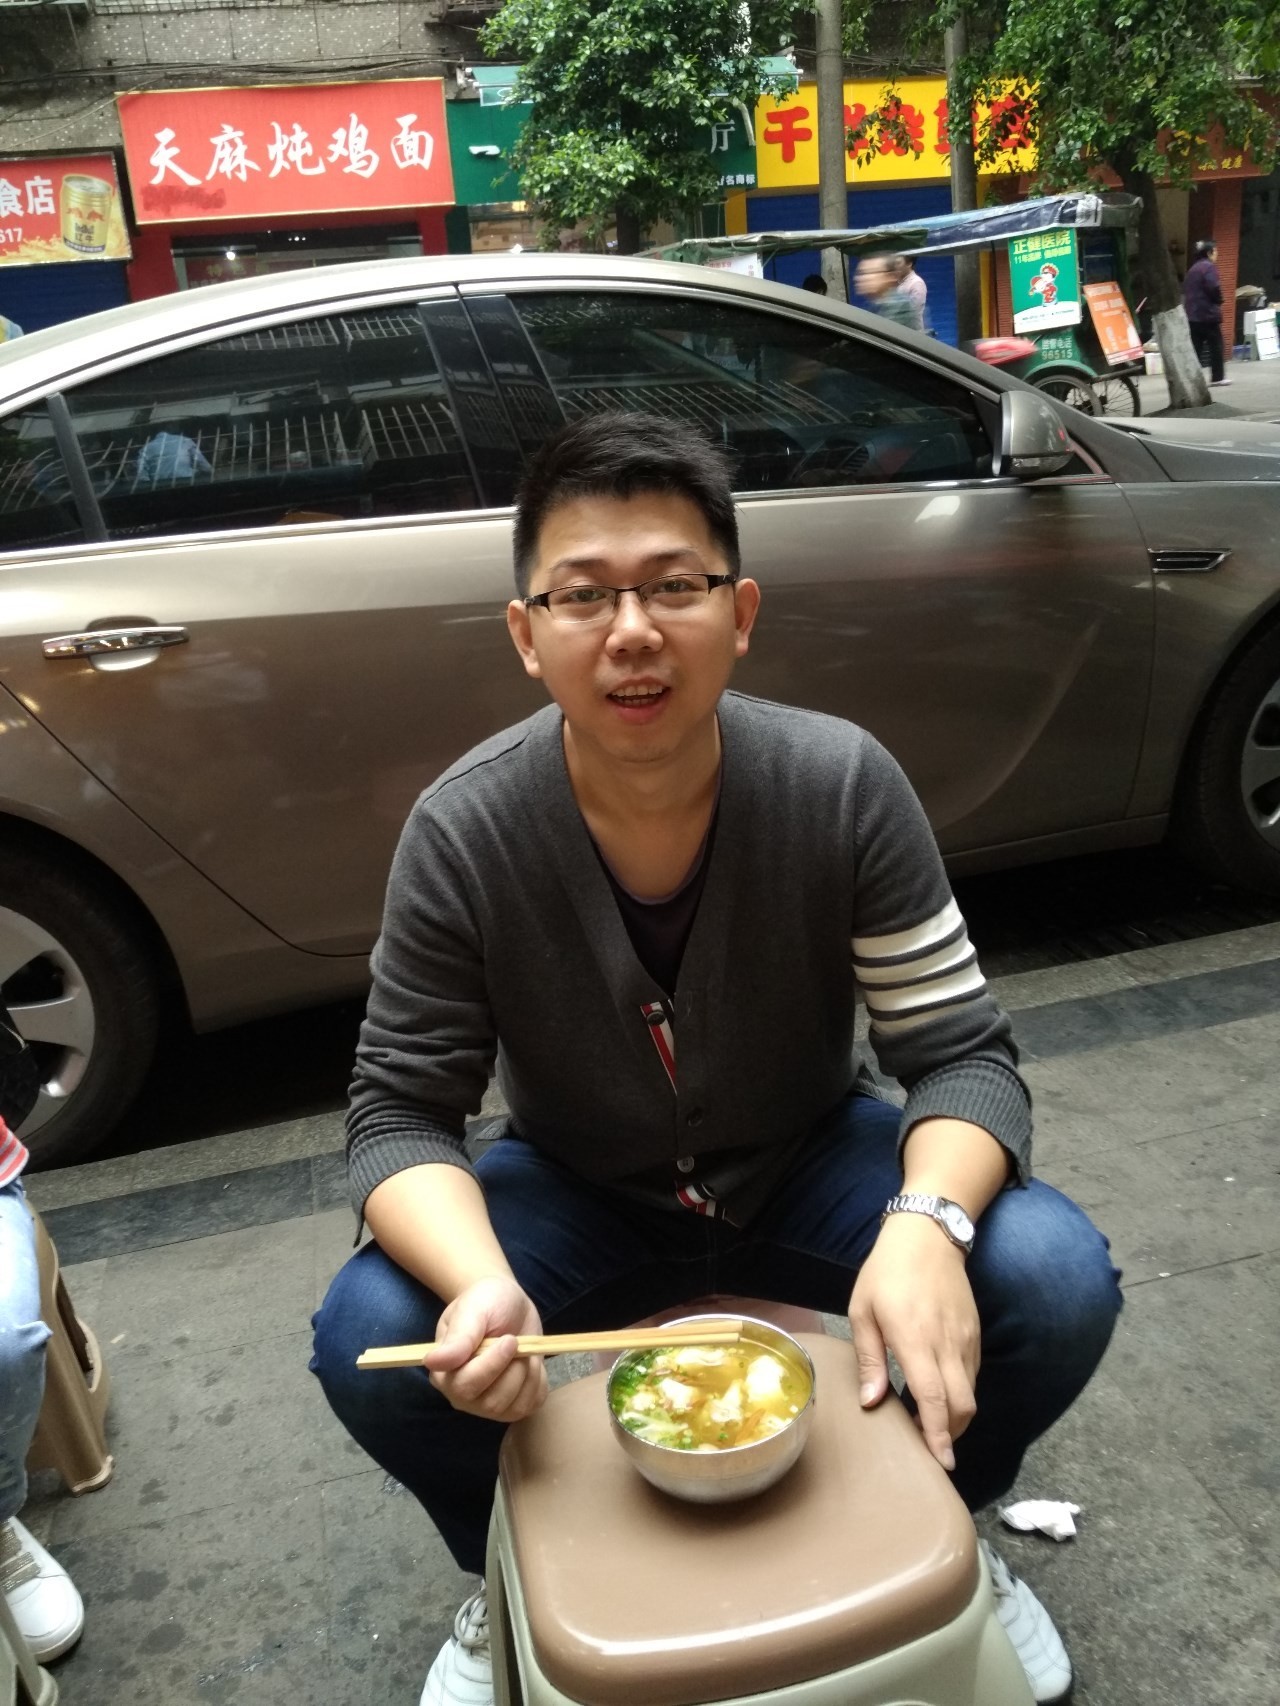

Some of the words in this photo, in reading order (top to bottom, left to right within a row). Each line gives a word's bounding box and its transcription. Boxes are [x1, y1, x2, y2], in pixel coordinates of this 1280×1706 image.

[149, 112, 434, 186] 天麻炖鸡面
